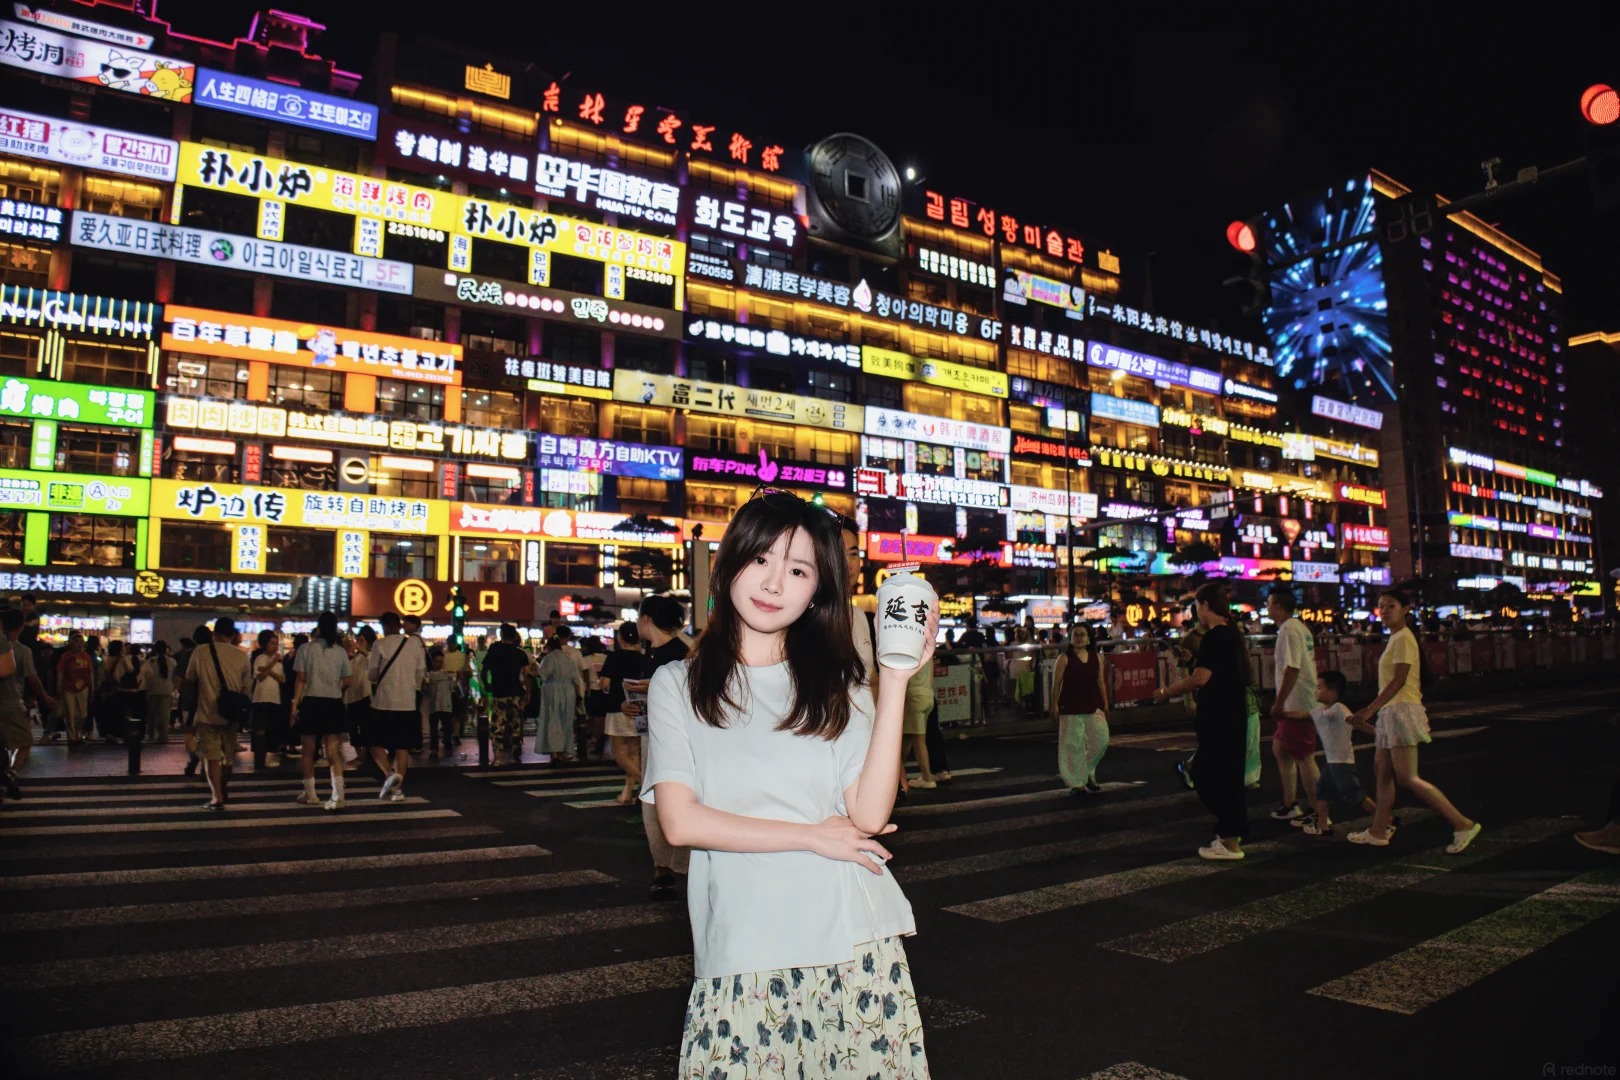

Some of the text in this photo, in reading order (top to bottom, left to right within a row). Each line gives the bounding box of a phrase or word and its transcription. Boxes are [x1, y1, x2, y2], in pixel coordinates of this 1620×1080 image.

[0, 28, 65, 66] 烤洞
[199, 151, 312, 199] 朴小炉
[566, 162, 680, 214] 华图教育
[80, 217, 201, 259] 爱久亚日式料理
[465, 203, 557, 244] 朴小炉
[695, 195, 797, 247] 화도교육
[243, 241, 401, 284] 아크아일식료리 5F
[689, 262, 734, 281] 2750555
[876, 293, 1002, 340] 청아의학미용 6F
[672, 383, 735, 410] 富二代
[541, 436, 681, 467] 自嗨魔方自助KTV
[110, 487, 129, 497] 入口
[179, 487, 427, 520] 炉边传 旋转自助烤肉
[240, 526, 257, 569] 韩式烤肉
[344, 532, 361, 574] 韩式烤肉
[0, 573, 134, 595] 服务大楼延吉冷面
[884, 595, 929, 627] 延吉
